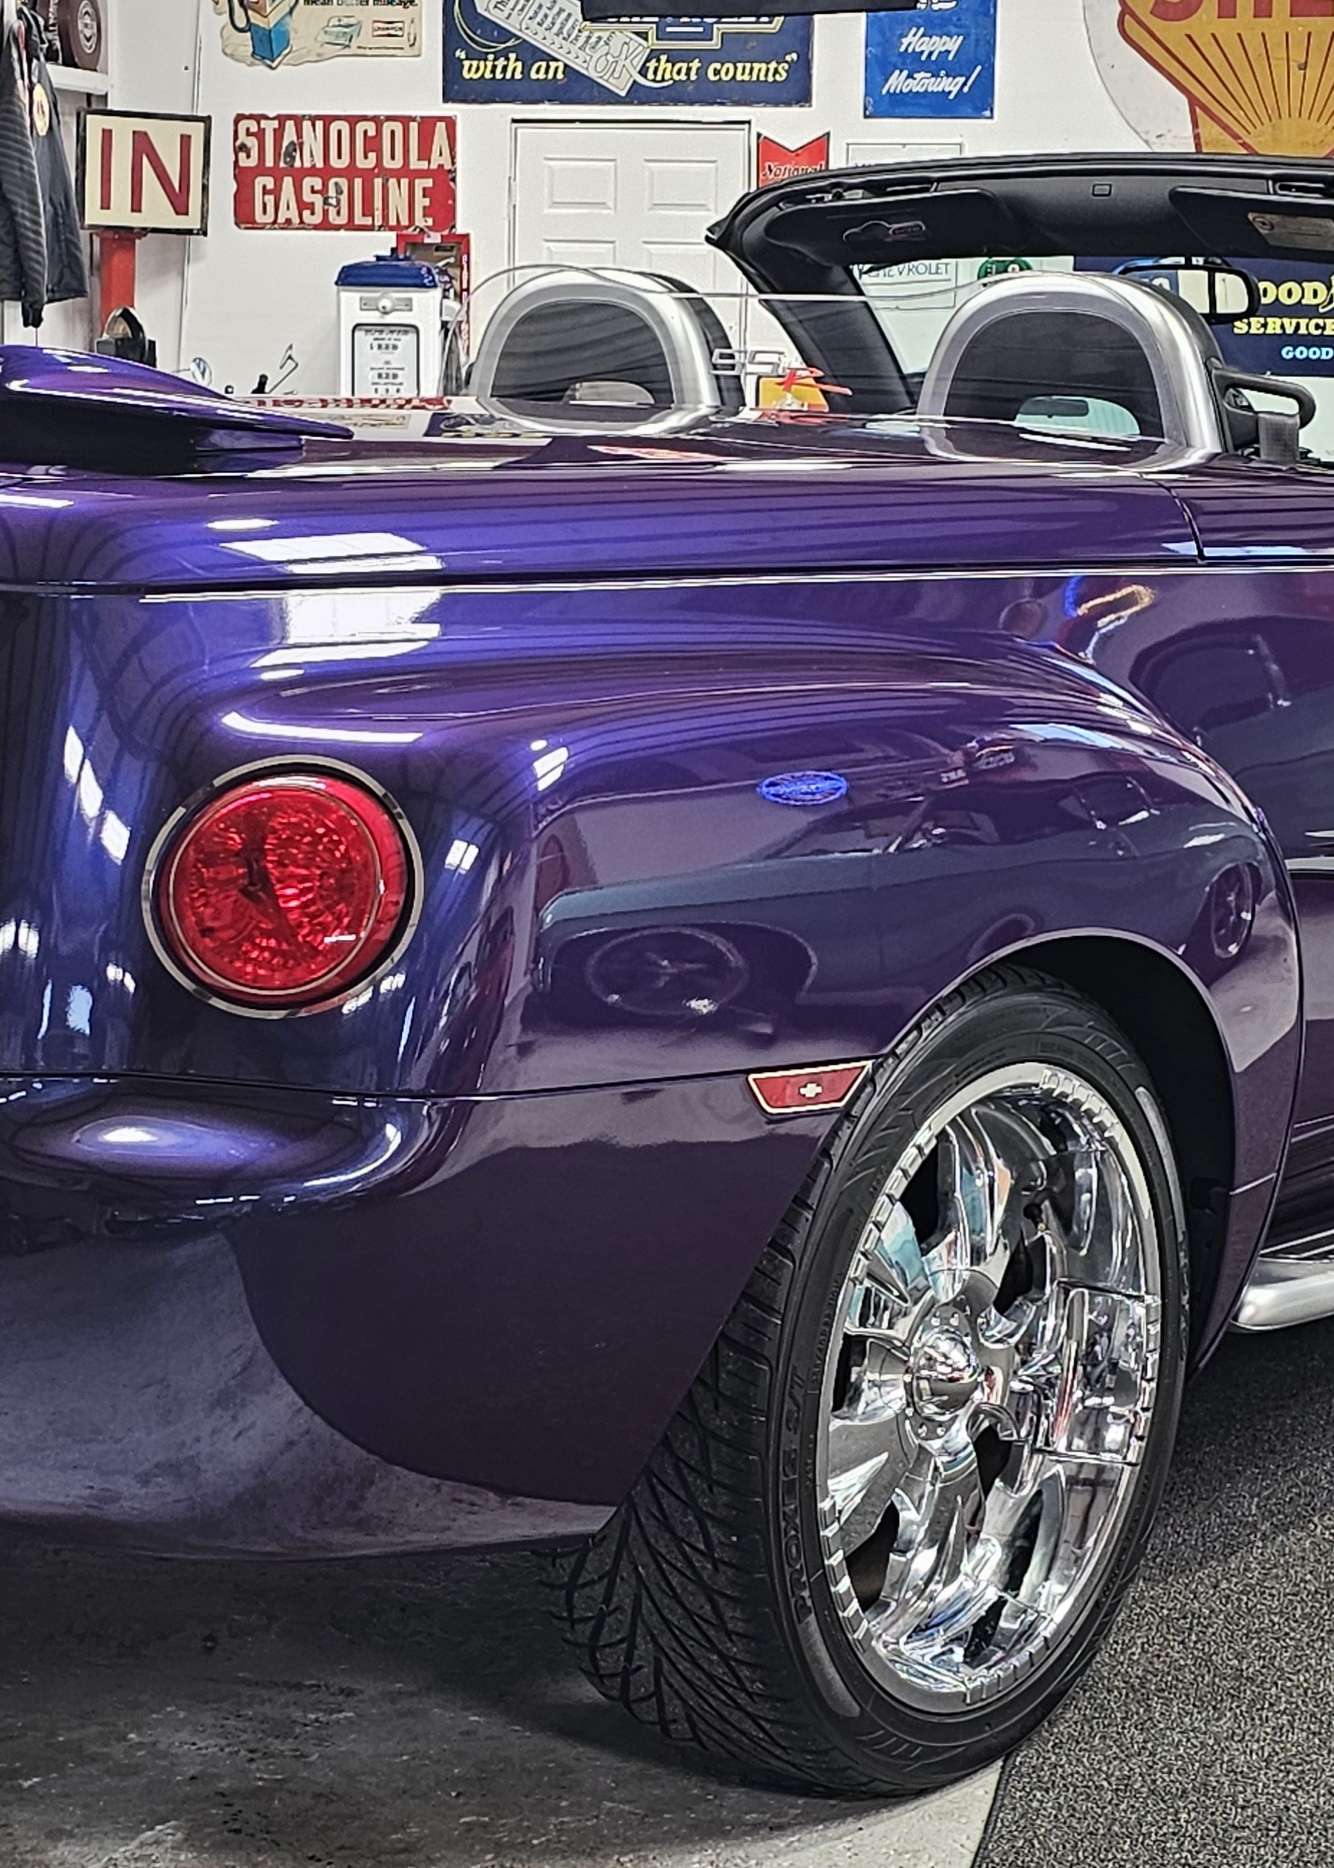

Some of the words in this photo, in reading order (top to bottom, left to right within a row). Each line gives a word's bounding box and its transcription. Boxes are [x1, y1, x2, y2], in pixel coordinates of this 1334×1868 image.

[899, 26, 964, 61] Happy
[529, 60, 565, 80] an
[646, 54, 701, 82] that
[881, 65, 982, 100] Motoring!
[236, 118, 453, 170] STANOCOLA
[101, 128, 192, 216] IN
[253, 175, 435, 227] GASOLINE
[1280, 345, 1334, 361] GOOD
